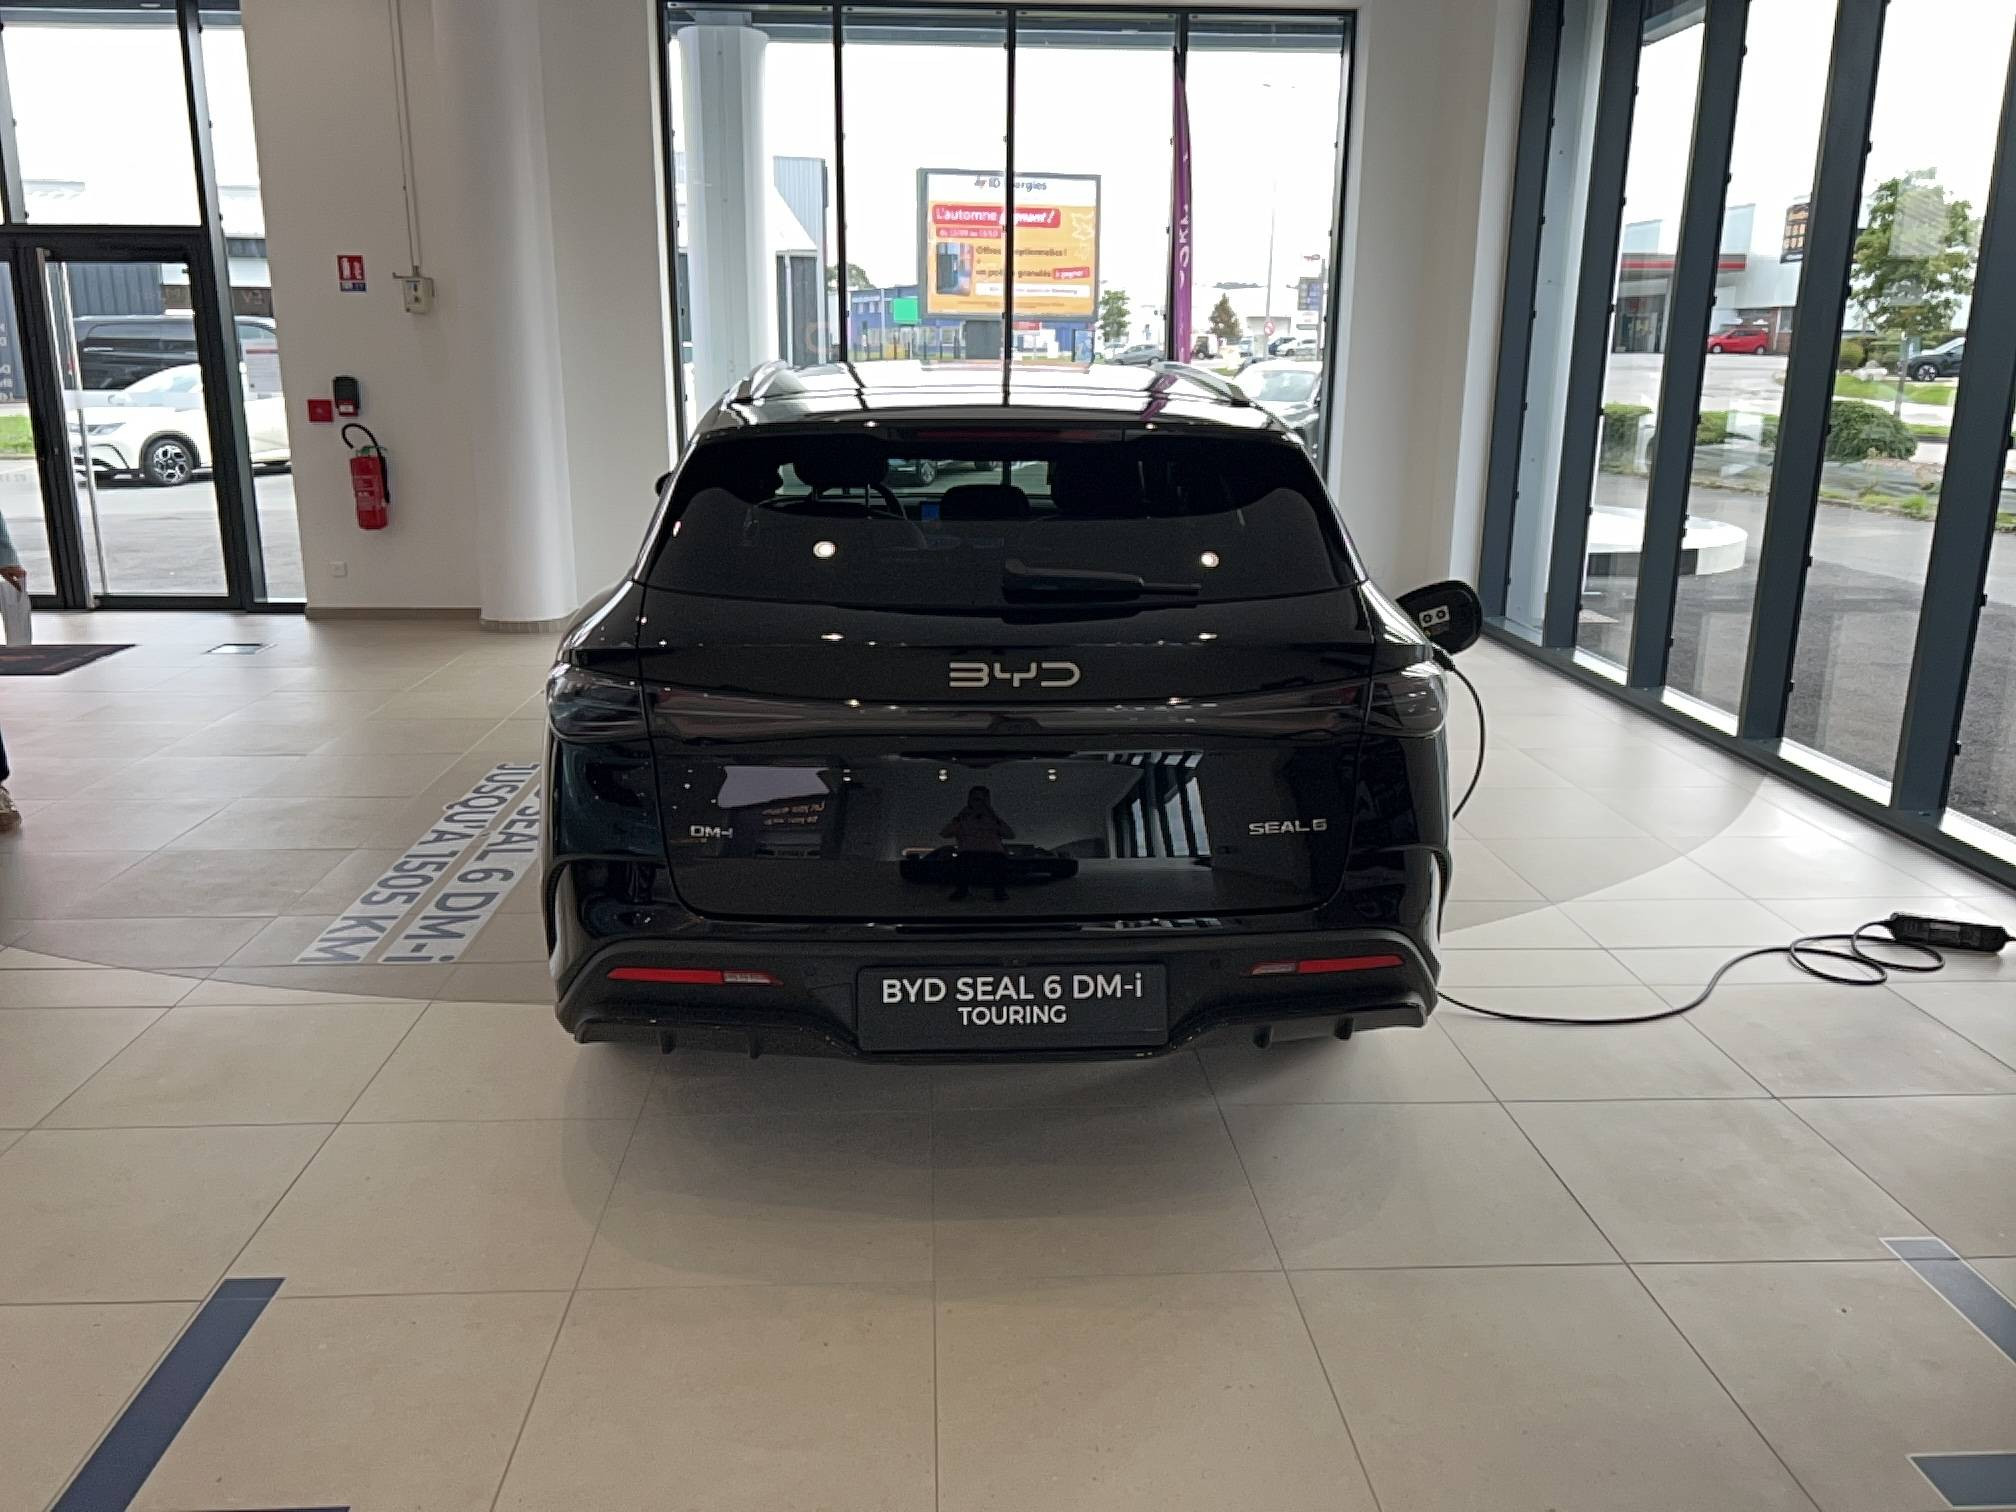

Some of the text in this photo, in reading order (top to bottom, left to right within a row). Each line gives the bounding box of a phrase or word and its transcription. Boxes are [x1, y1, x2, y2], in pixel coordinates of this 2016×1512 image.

[936, 208, 998, 220] L'automne
[949, 662, 1081, 687] BYD
[1248, 820, 1311, 835] SEAL
[360, 850, 461, 906] 1505
[457, 868, 514, 883] 6
[296, 915, 400, 963] KM
[882, 972, 1143, 1004] BYD SEAL 6 DM-i
[958, 1005, 1067, 1026] TOURING
